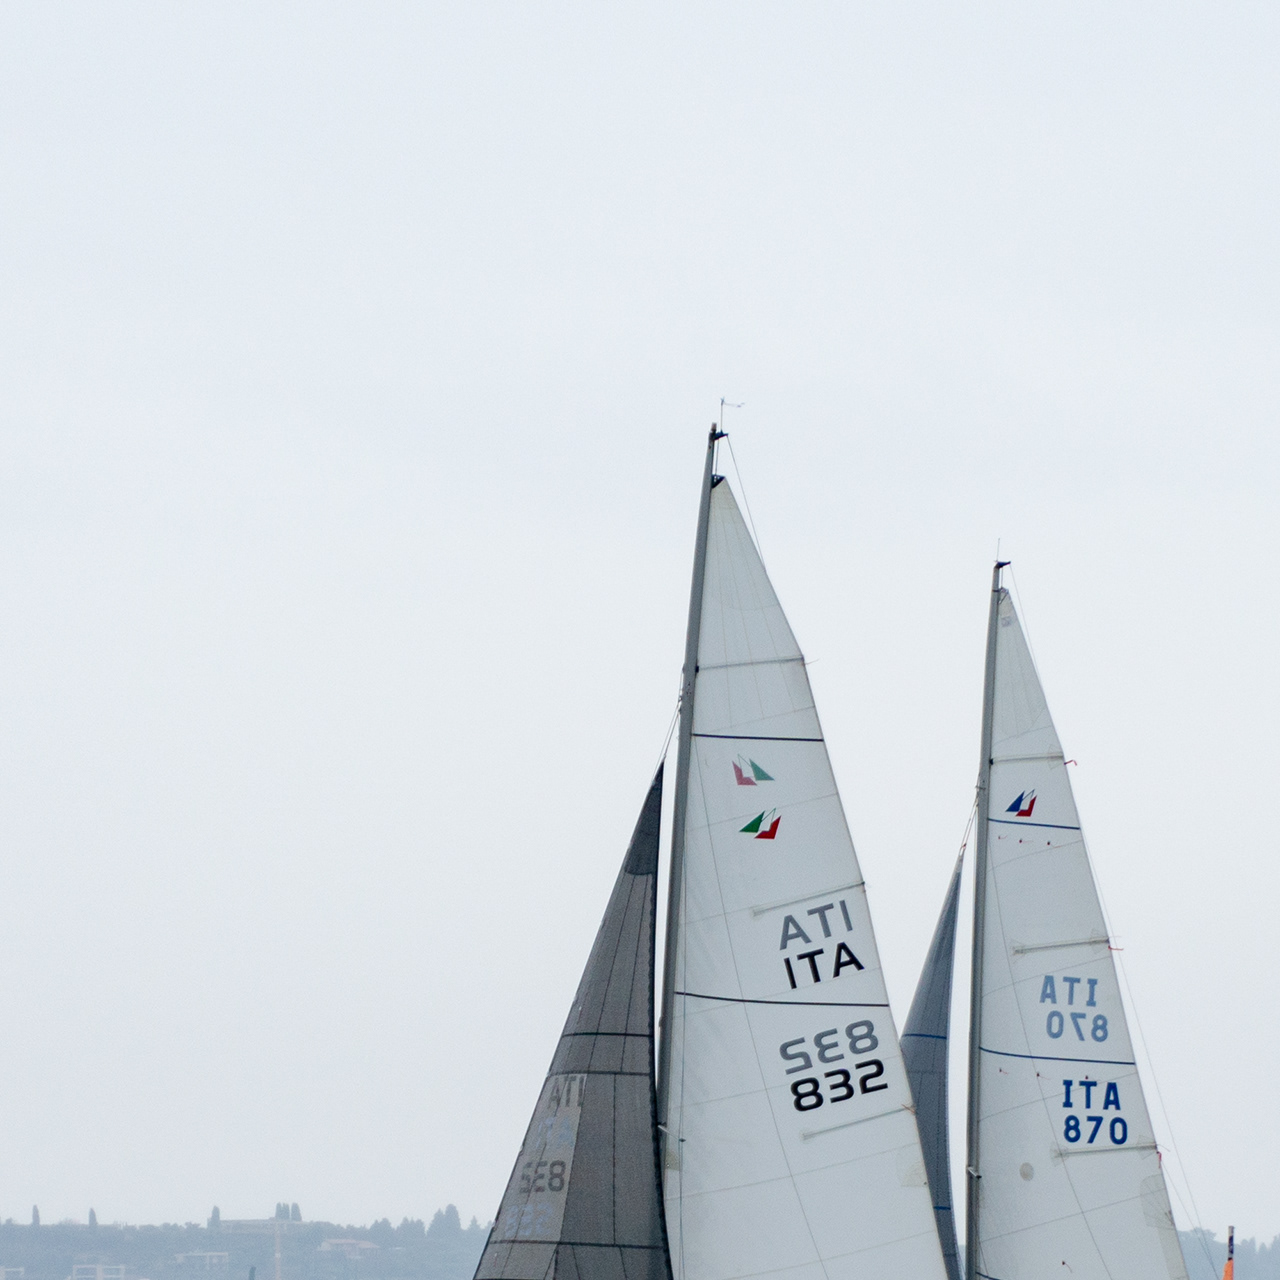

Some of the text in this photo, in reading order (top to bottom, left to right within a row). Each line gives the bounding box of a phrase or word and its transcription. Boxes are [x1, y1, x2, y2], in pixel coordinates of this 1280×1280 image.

[783, 941, 865, 990] ITA
[790, 1058, 888, 1112] 832
[1062, 1079, 1121, 1110] ITA
[1063, 1114, 1128, 1145] 870
